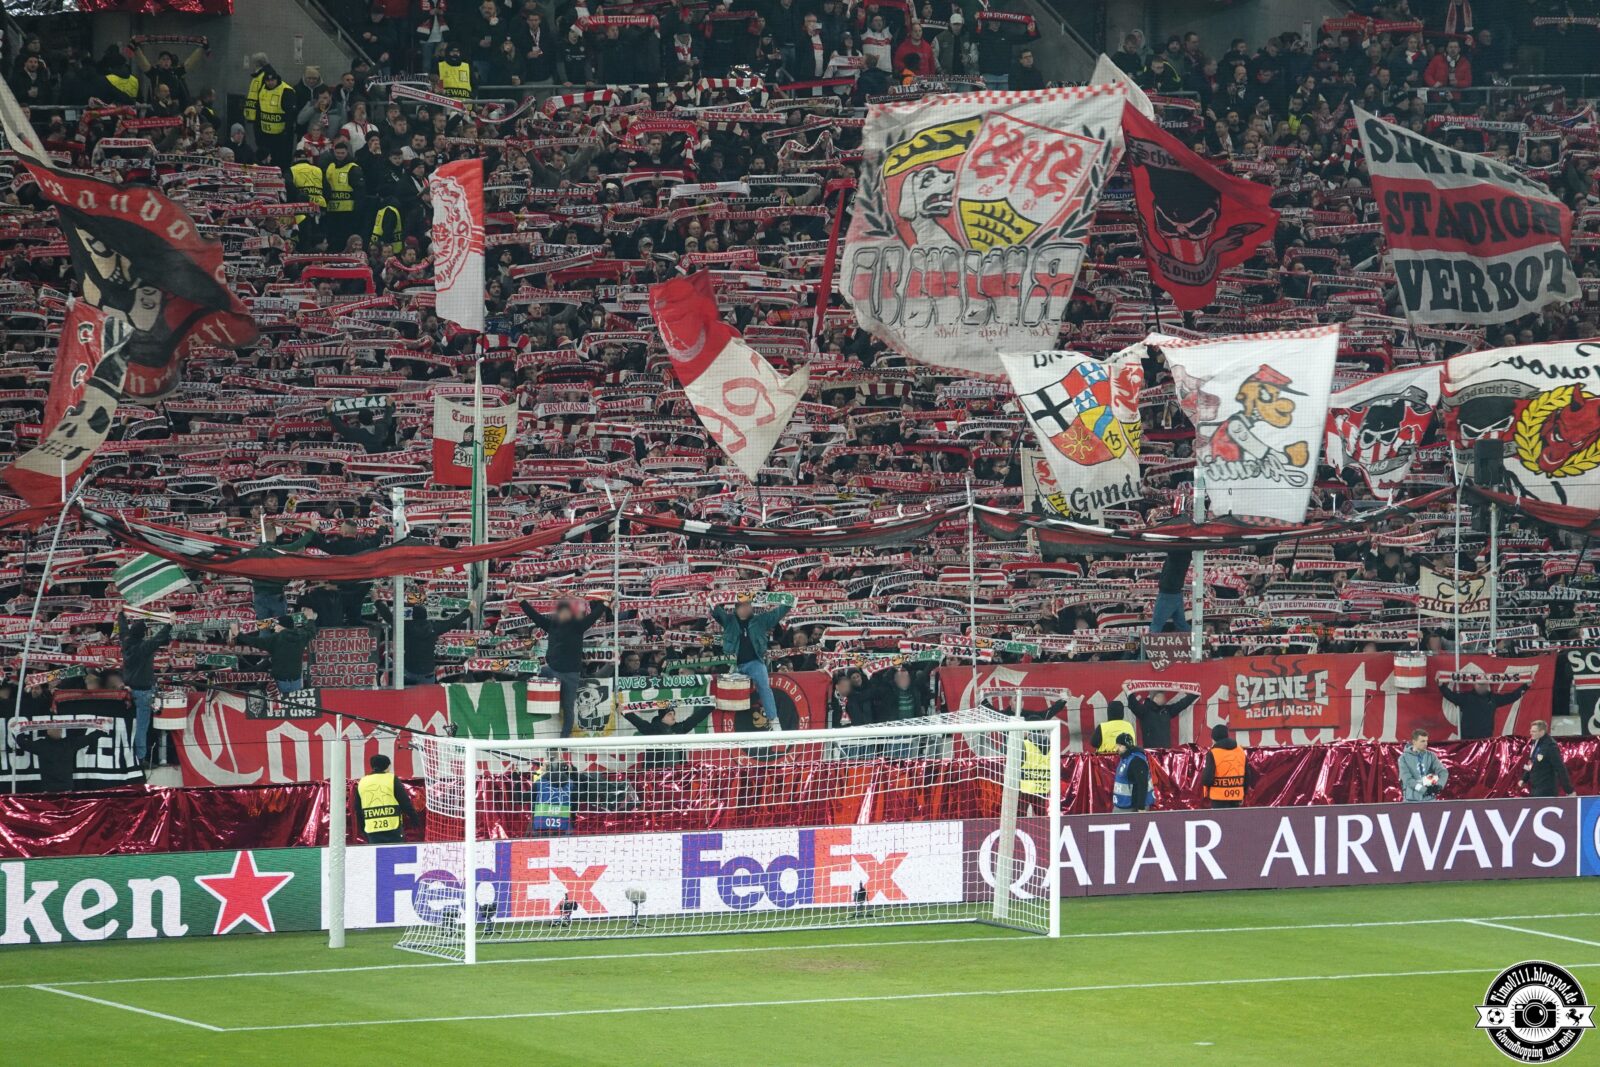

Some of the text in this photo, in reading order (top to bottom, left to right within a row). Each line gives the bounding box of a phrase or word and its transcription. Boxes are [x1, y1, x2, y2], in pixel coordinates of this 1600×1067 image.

[1384, 190, 1562, 245] STADION
[1394, 249, 1574, 312] VERBOT
[544, 403, 591, 414] ERSTKLASSIG
[316, 628, 369, 639] JEDER
[1344, 629, 1409, 640] ULT RAS
[310, 638, 377, 652] VERBANNTE
[1143, 635, 1184, 646] ULTRA
[1218, 635, 1243, 645] ULT
[1256, 636, 1282, 645] RAS
[316, 652, 371, 663] KEHRT
[617, 675, 697, 690] AVEC NOUS
[1452, 672, 1521, 683] ULT RAS
[1235, 670, 1329, 708] SZENE E
[685, 697, 711, 706] RAS
[1246, 704, 1323, 718] REUTLINGEN
[1224, 789, 1241, 798] 099
[372, 819, 389, 829] 228
[545, 818, 561, 828] 025
[978, 806, 1567, 900] QATAR AIRWAYS
[682, 827, 909, 910] FedEx
[375, 840, 609, 924] FedEx
[0, 862, 189, 945] ken
